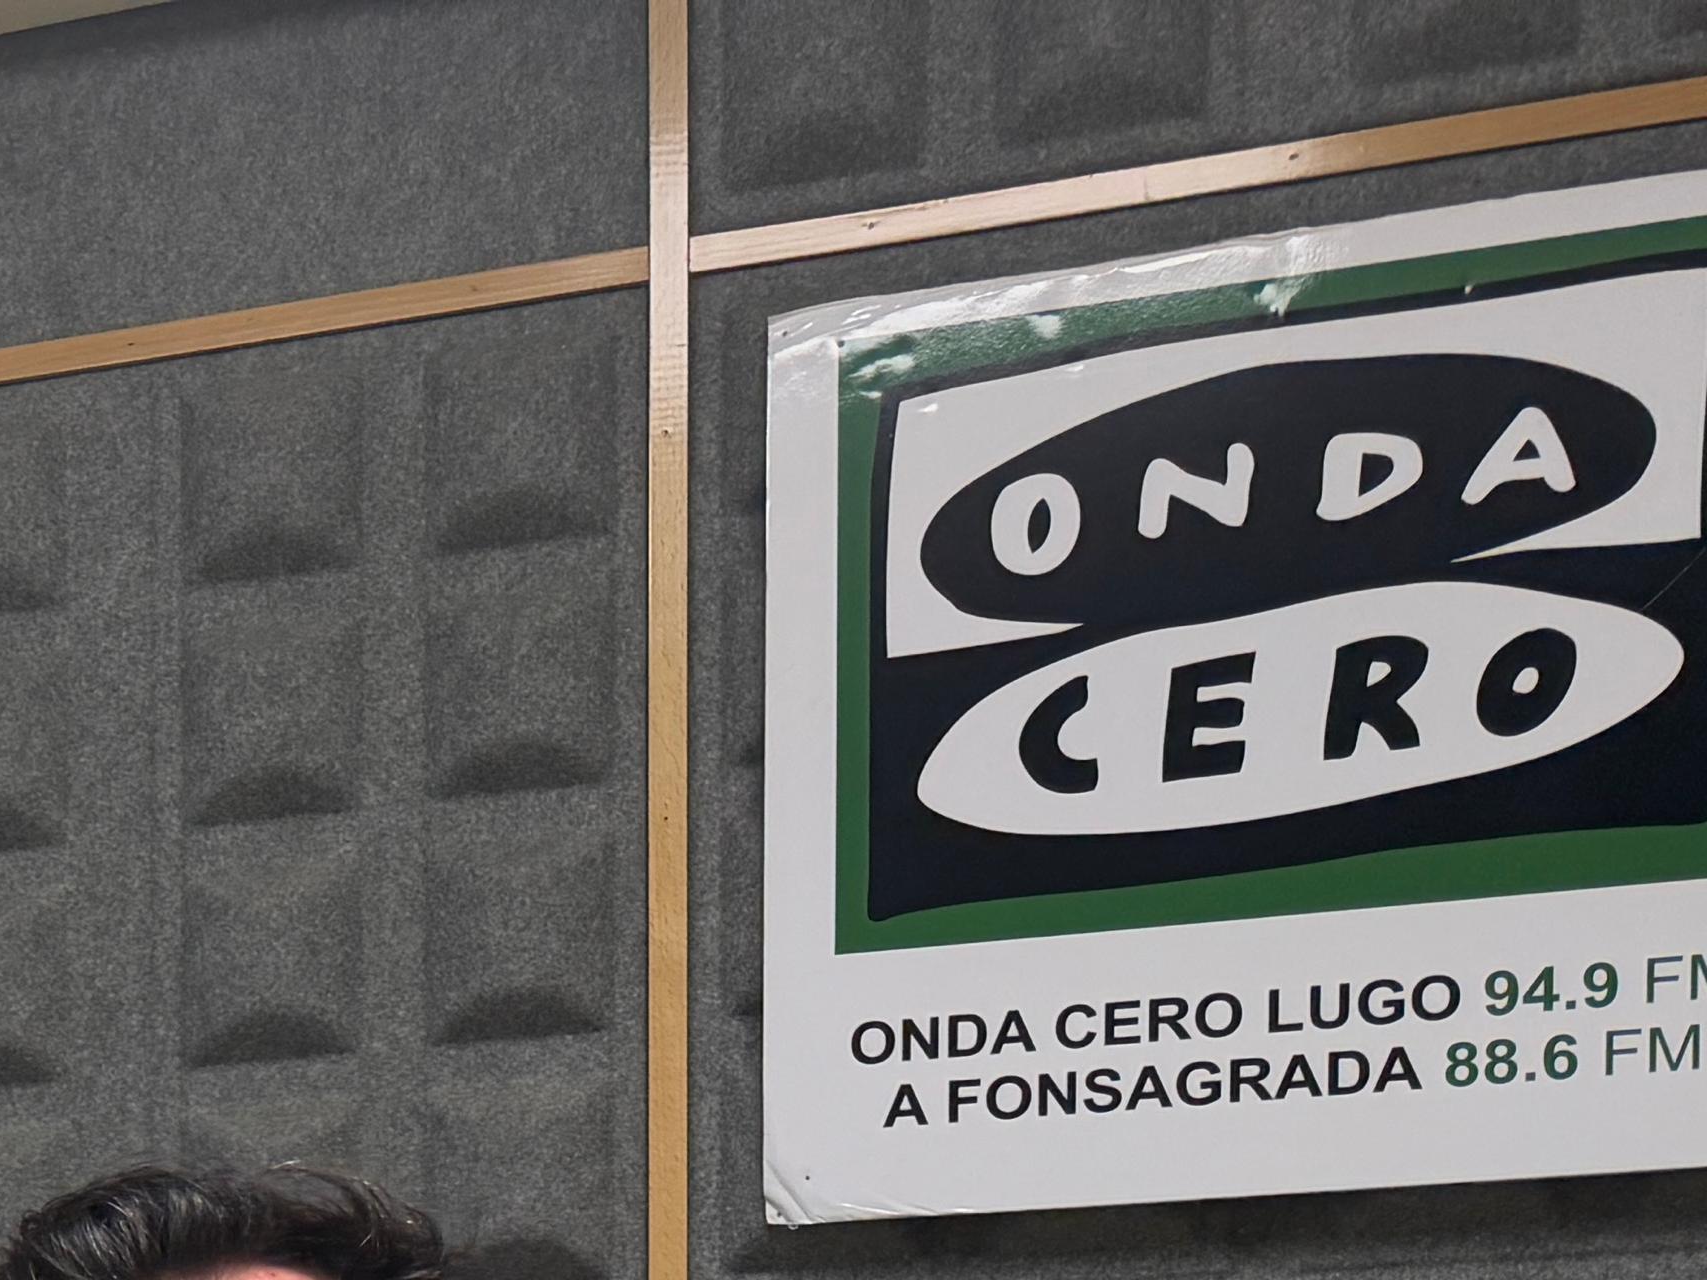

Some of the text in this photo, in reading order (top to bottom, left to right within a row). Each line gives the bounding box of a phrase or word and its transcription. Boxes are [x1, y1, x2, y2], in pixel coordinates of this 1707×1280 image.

[989, 406, 1578, 576] ONDA
[1017, 627, 1579, 794] CERO
[851, 1010, 1037, 1065] ONDA
[1056, 993, 1242, 1049] CERO
[1269, 975, 1460, 1033] LUGO
[1485, 962, 1618, 1016] 94.9
[883, 1024, 1700, 1127] A FONSAGRADA 88.6 FM
